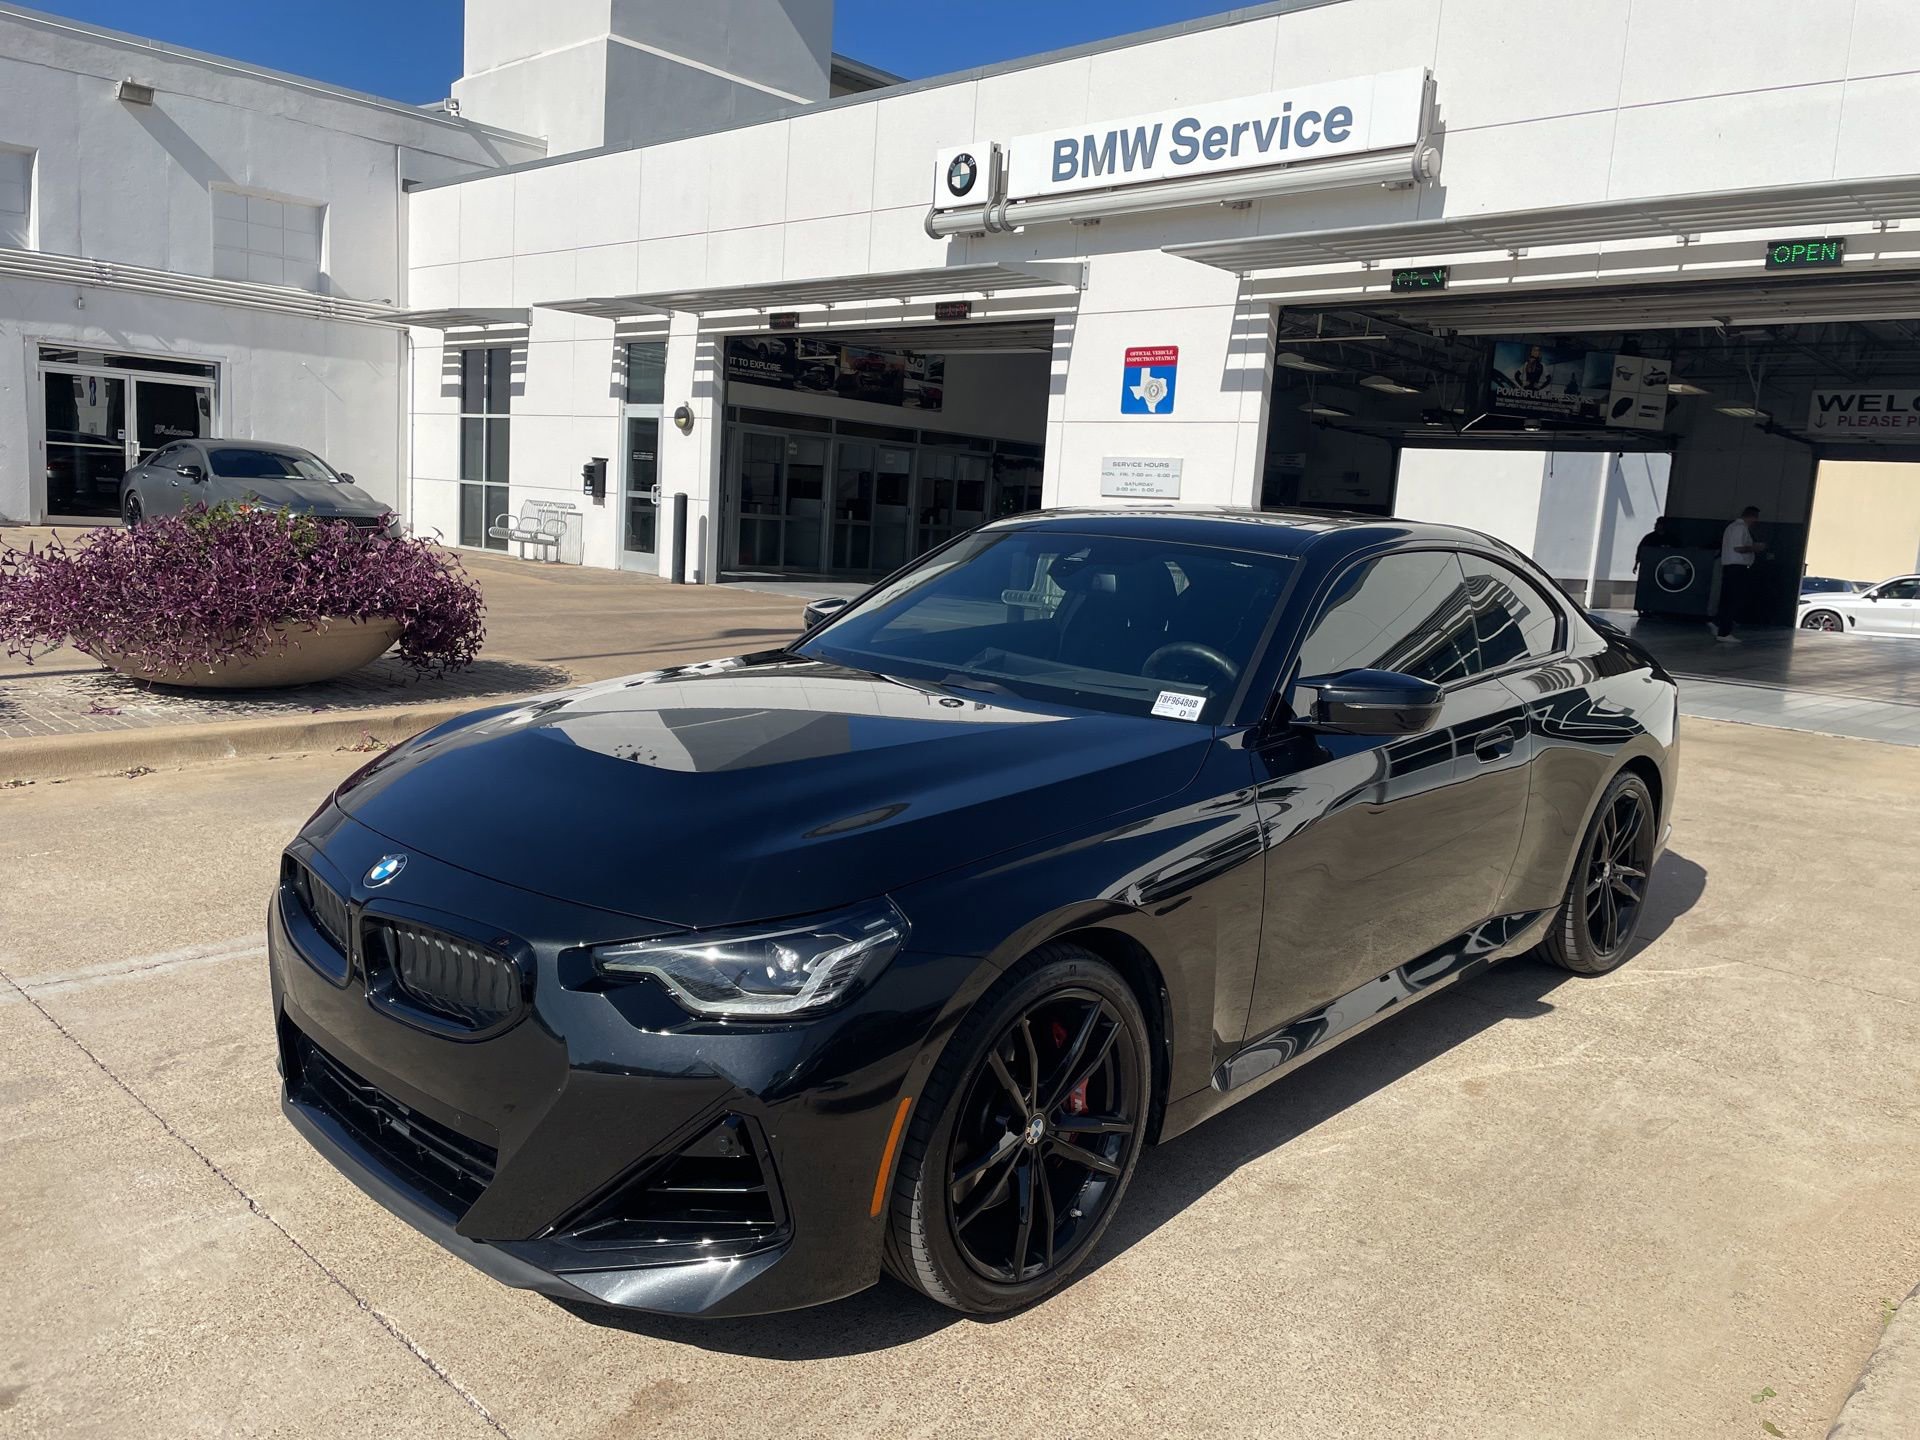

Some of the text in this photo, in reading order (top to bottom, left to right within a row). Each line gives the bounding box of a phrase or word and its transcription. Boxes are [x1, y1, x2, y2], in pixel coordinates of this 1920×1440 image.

[1052, 101, 1353, 182] BMW Service
[1774, 242, 1837, 263] OPEN
[738, 358, 749, 367] TO
[1496, 387, 1541, 399] POWERFUL
[1837, 415, 1920, 427] PLEASE P
